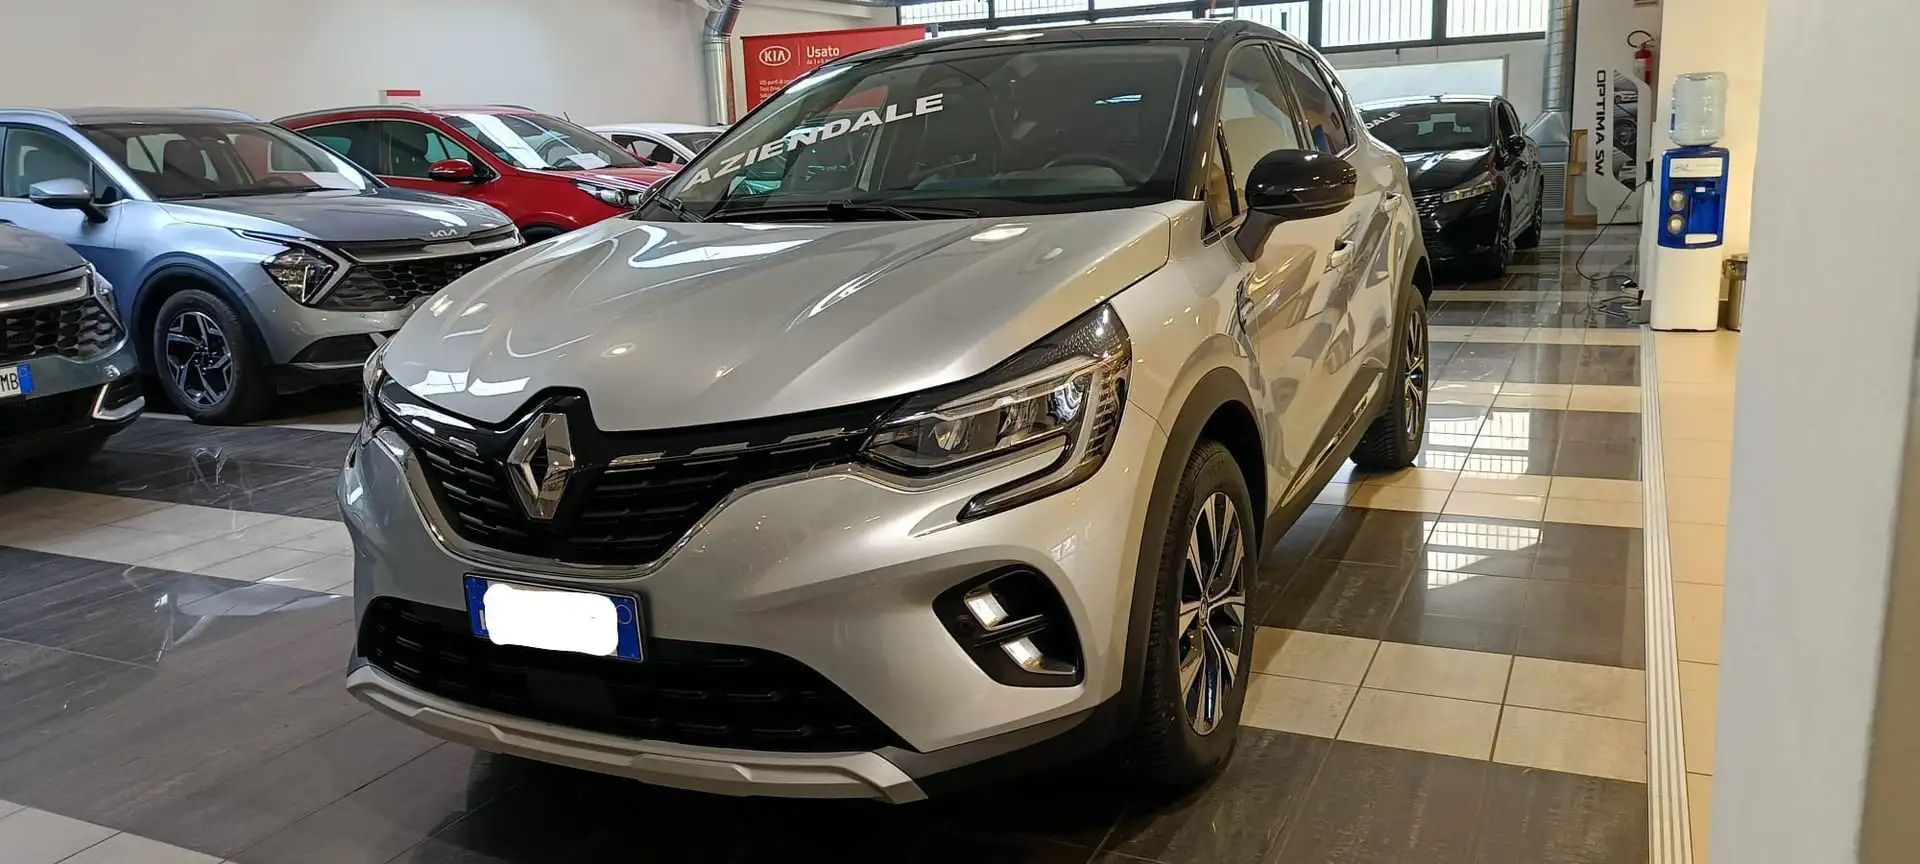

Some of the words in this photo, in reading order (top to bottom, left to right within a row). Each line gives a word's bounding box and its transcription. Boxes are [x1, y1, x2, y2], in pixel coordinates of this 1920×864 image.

[764, 50, 786, 62] KIA
[806, 46, 840, 58] Usato
[1595, 70, 1606, 145] OPTIMA
[681, 93, 944, 192] AZIENDALE
[1595, 150, 1605, 176] SW
